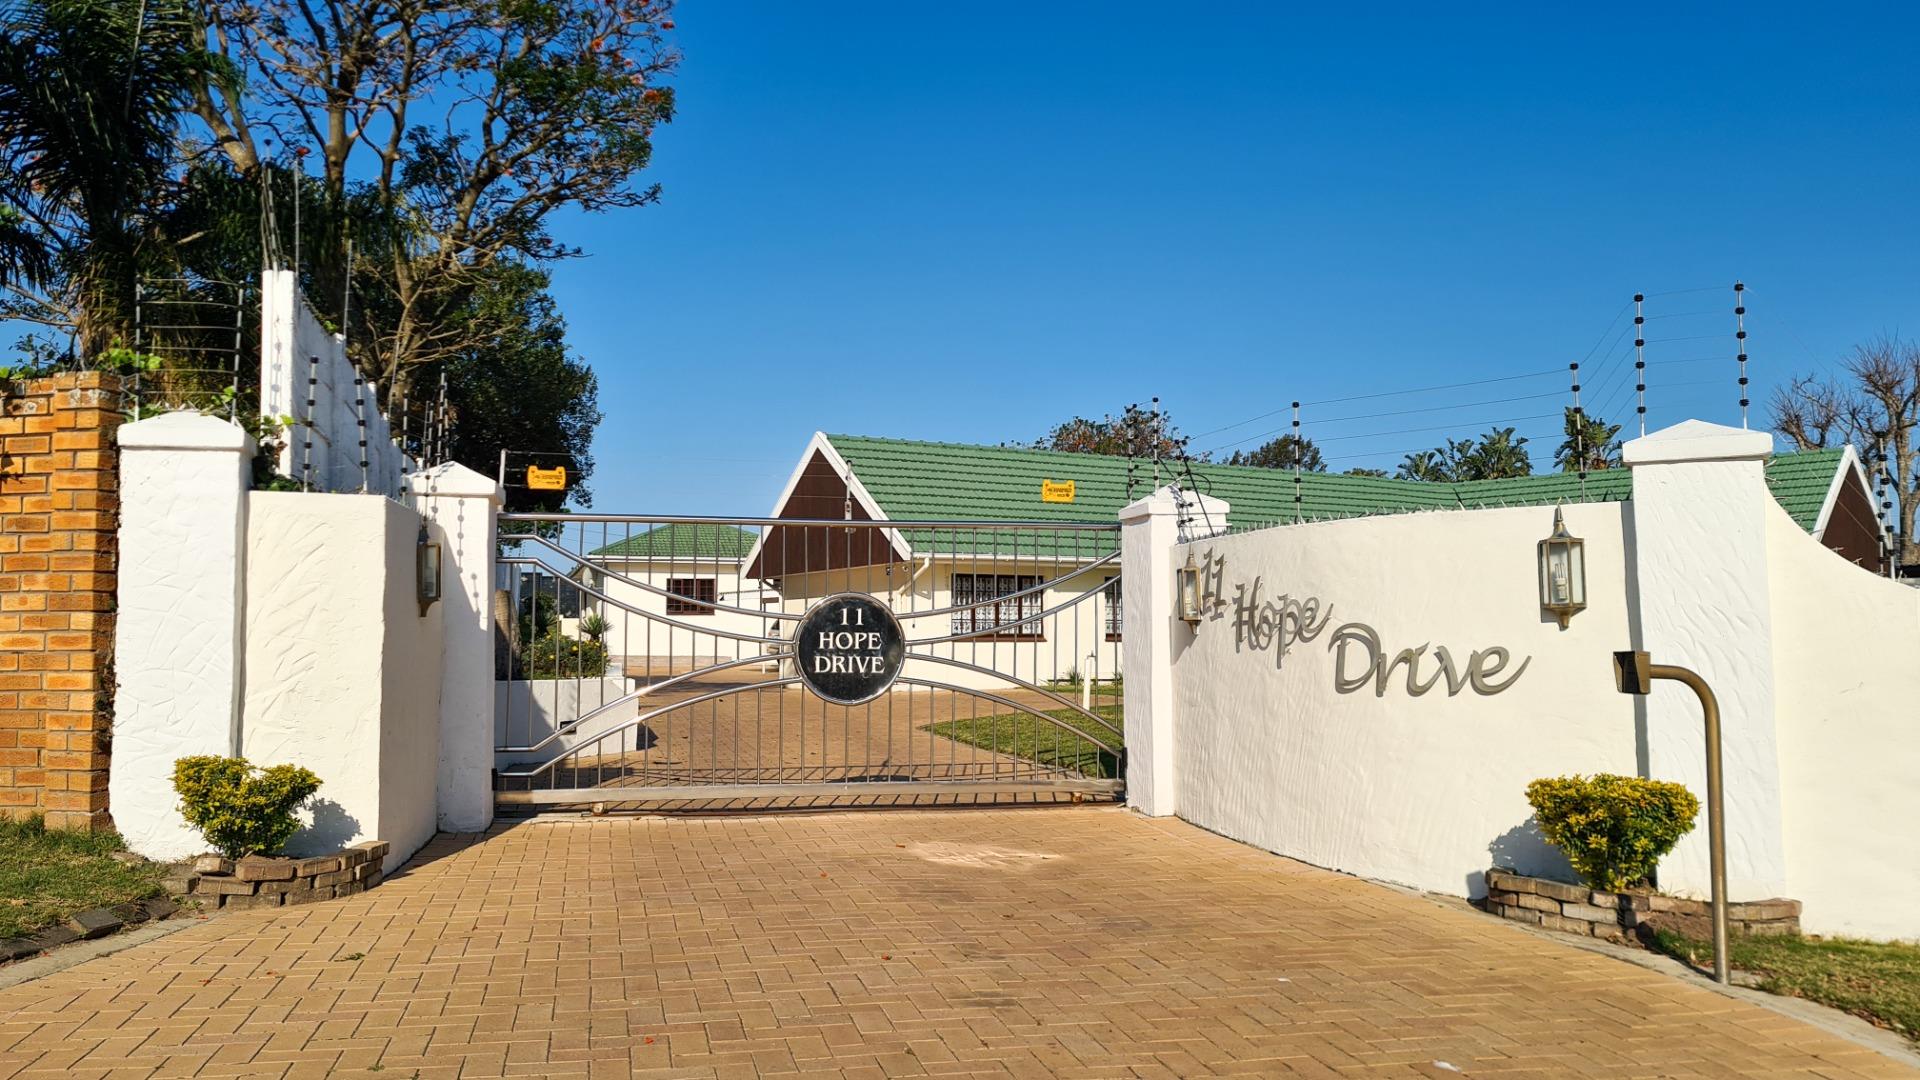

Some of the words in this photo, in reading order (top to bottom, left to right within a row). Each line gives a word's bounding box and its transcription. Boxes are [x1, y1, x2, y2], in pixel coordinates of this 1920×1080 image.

[840, 608, 864, 626] 11
[1201, 547, 1227, 616] 11
[1231, 575, 1334, 667] Hope
[1328, 622, 1532, 697] Drive
[818, 631, 882, 650] HOPE
[814, 655, 885, 674] DRIVE
